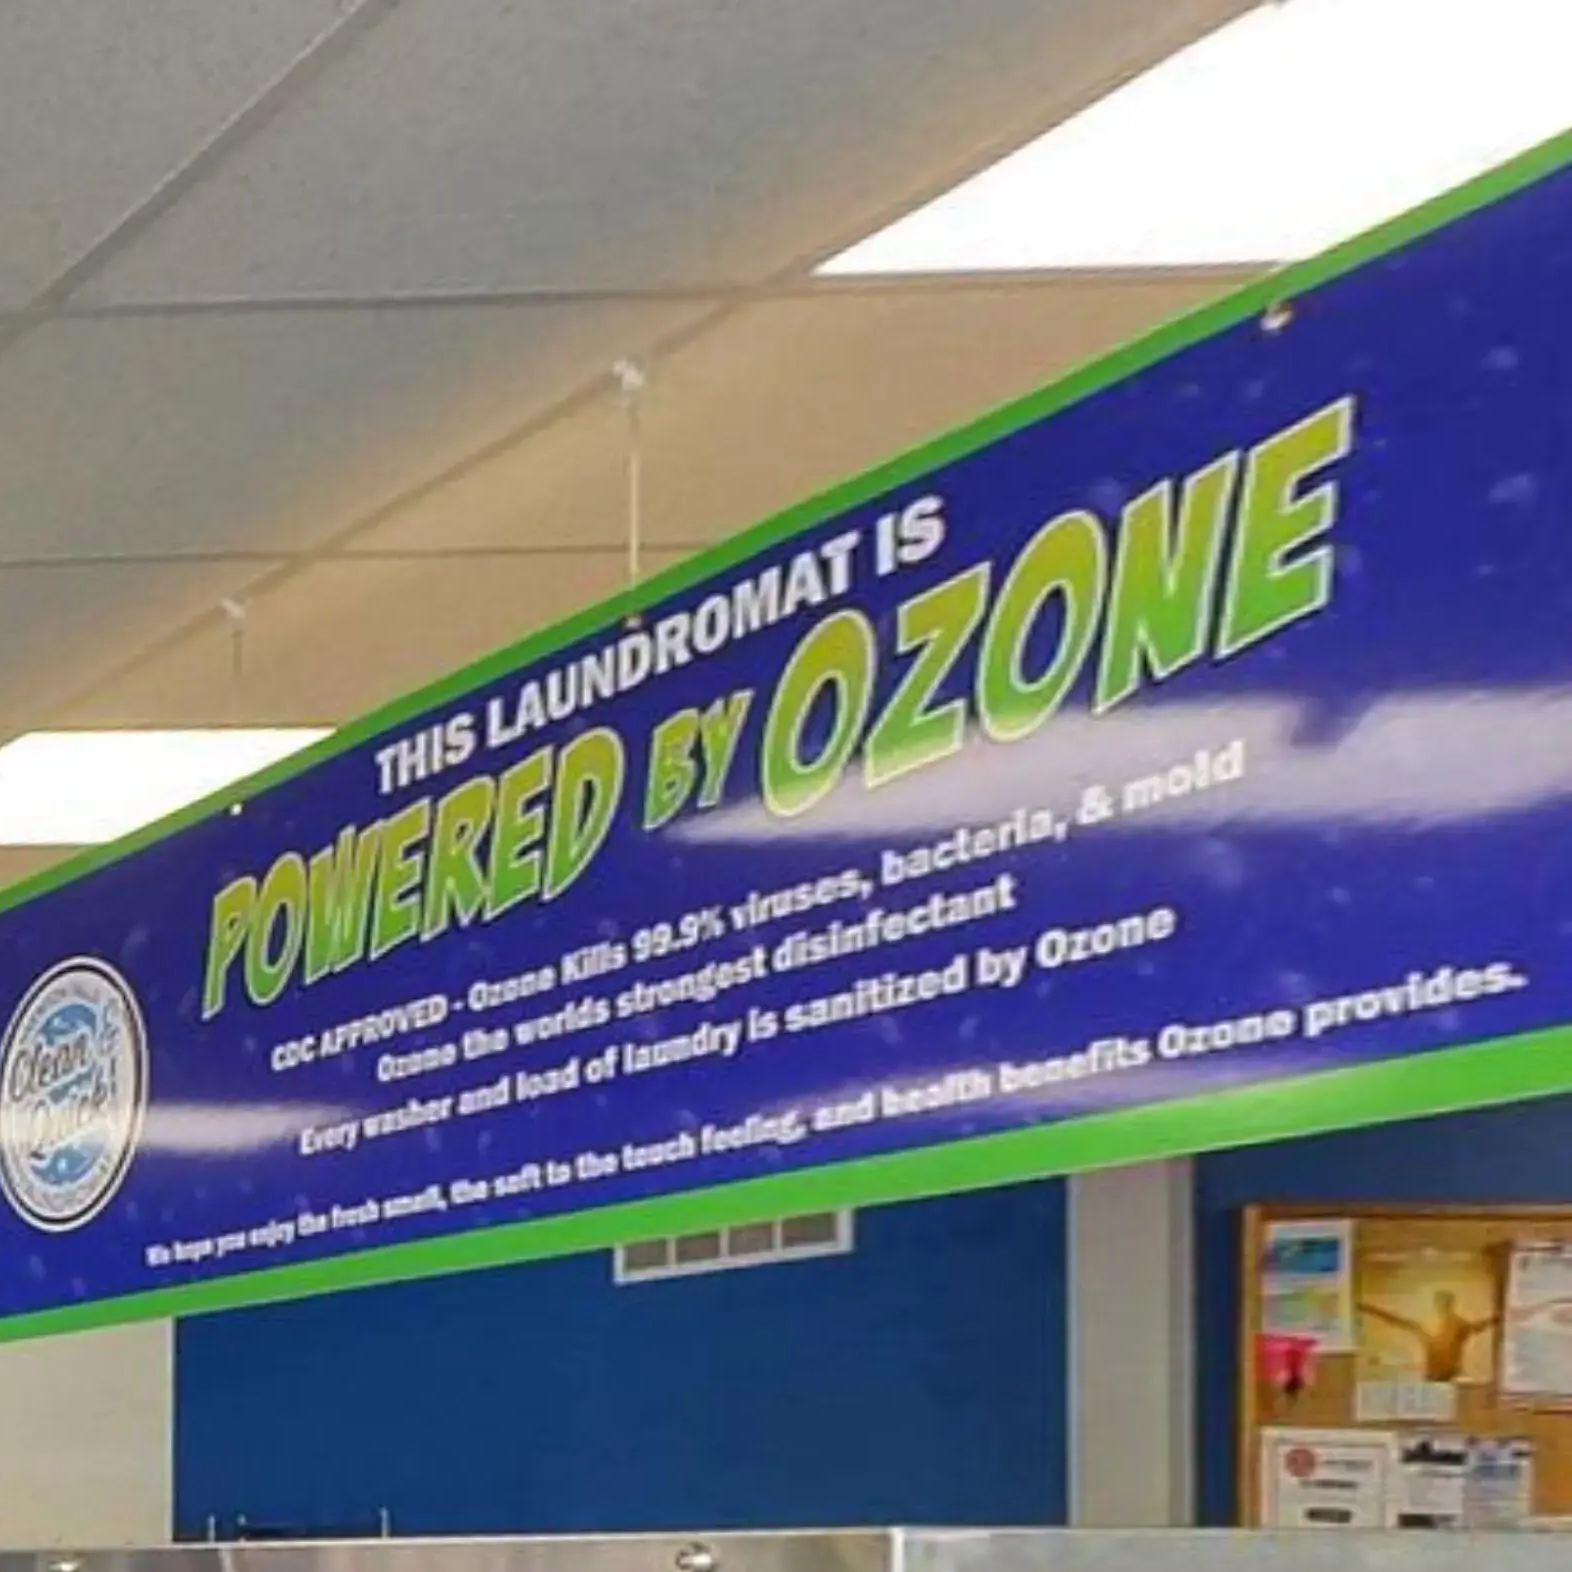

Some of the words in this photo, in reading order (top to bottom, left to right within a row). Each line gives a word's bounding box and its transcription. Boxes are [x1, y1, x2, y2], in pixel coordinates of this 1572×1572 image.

[201, 726, 625, 1021] POWERED
[644, 690, 754, 831] BY
[760, 395, 1355, 817] OZONE
[375, 711, 475, 794] THIS
[487, 531, 859, 747] LAUNDROMAT
[875, 495, 945, 577] IS
[270, 1034, 318, 1073] CDC
[319, 993, 449, 1059] APPROVED
[467, 962, 555, 1012] Ozone
[560, 941, 629, 987] Kills
[631, 903, 726, 965] 99.9%
[730, 866, 876, 931] viruses,
[880, 806, 1069, 886] bacteria,
[1075, 783, 1116, 827] &
[1121, 738, 1247, 813] mold
[298, 1117, 359, 1156] Every
[363, 1092, 454, 1139] washer
[458, 1075, 511, 1117] and
[515, 1055, 582, 1103] load
[585, 1042, 621, 1085] of
[621, 1016, 744, 1076] laundry
[746, 1006, 780, 1043] is
[783, 953, 970, 1034] sanitized
[975, 944, 1030, 989] by
[1034, 904, 1178, 970] Ozone
[376, 1041, 458, 1083] Ozone
[462, 1025, 510, 1063] the
[513, 993, 611, 1045] worlds
[615, 943, 769, 1020] strongest
[770, 870, 1018, 976] disinfectant
[545, 1159, 572, 1186] to
[574, 1151, 620, 1182] the
[621, 1129, 696, 1172] touch
[810, 1090, 877, 1131] and
[880, 1066, 993, 1116] health
[999, 1036, 1151, 1096] benefits
[1156, 1006, 1297, 1060] Ozone
[1304, 958, 1529, 1040] provides.
